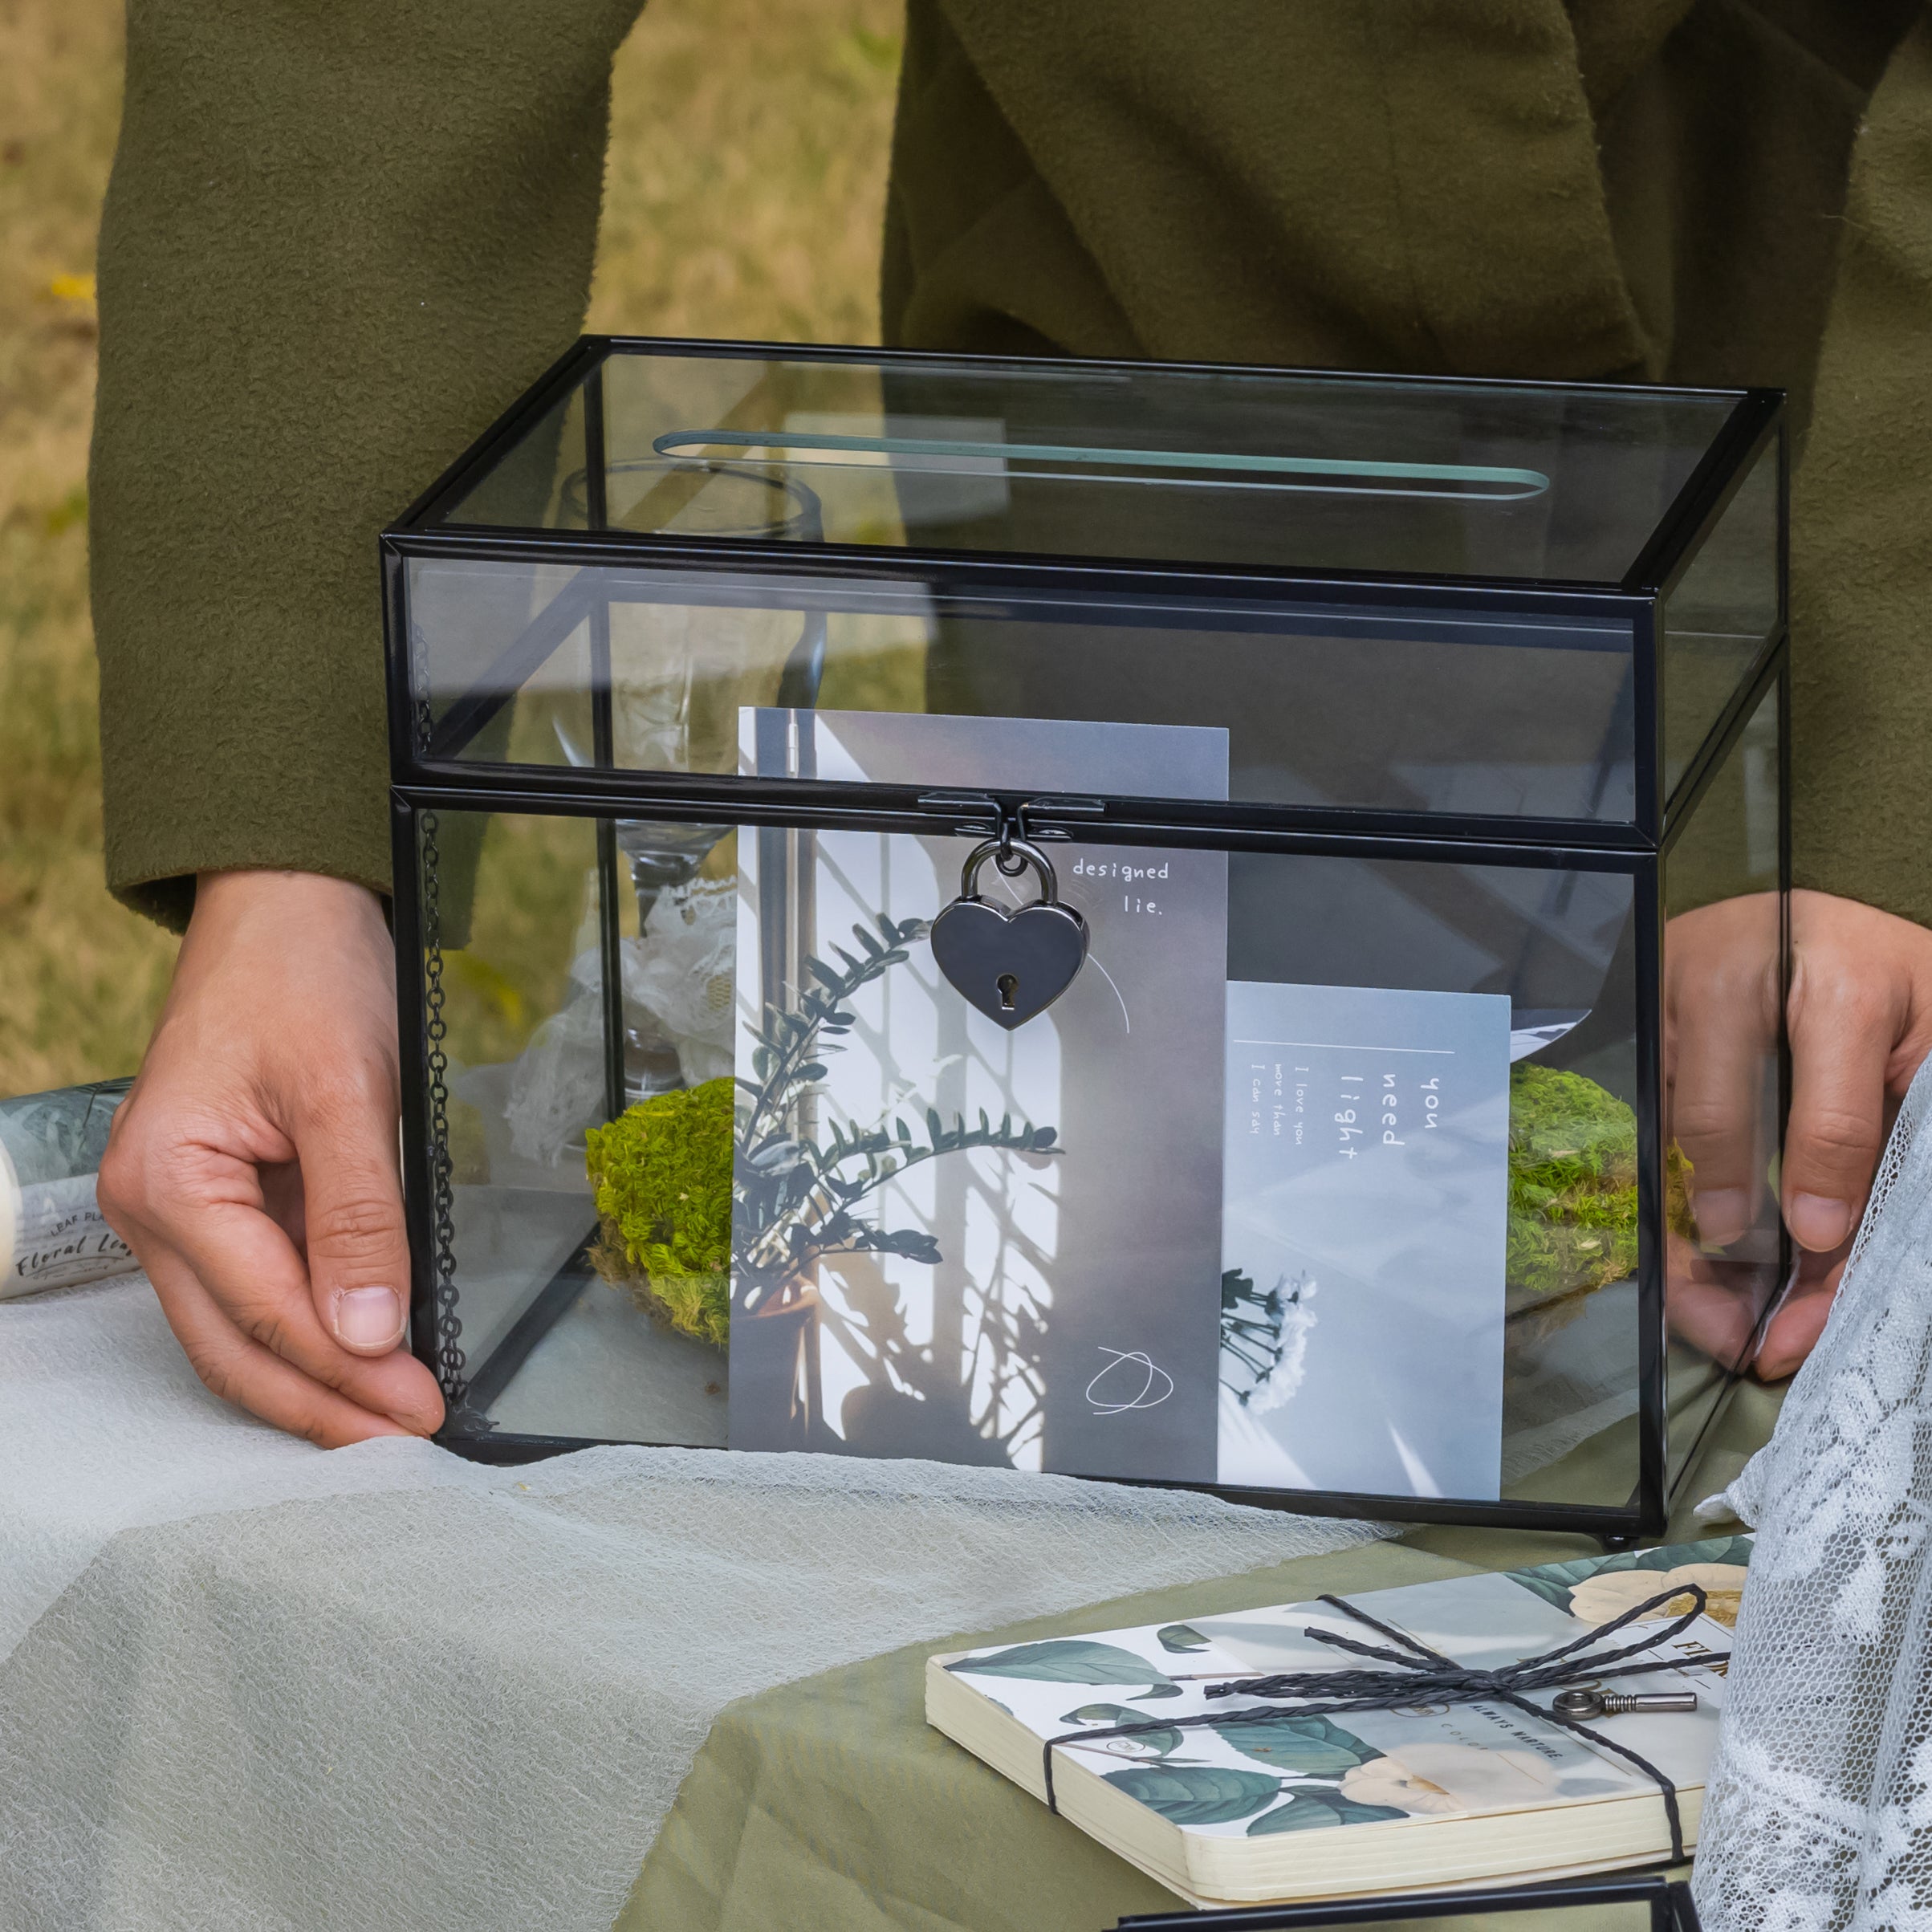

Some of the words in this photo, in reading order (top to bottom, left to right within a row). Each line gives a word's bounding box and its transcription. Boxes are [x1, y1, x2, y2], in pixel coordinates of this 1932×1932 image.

[1072, 858, 1169, 882] designed
[1124, 895, 1162, 916] lie.
[1252, 1078, 1262, 1102] can
[1274, 1064, 1283, 1096] more
[1295, 1084, 1308, 1113] love
[1381, 1073, 1405, 1145] need
[1420, 1077, 1439, 1129] you
[1250, 1111, 1260, 1134] say
[1273, 1104, 1286, 1136] than
[1334, 1076, 1364, 1160] light
[1293, 1121, 1304, 1145] you
[50, 1214, 78, 1237] LEAF
[15, 1235, 87, 1276] Floral
[1468, 1705, 1514, 1729] ALWAYS
